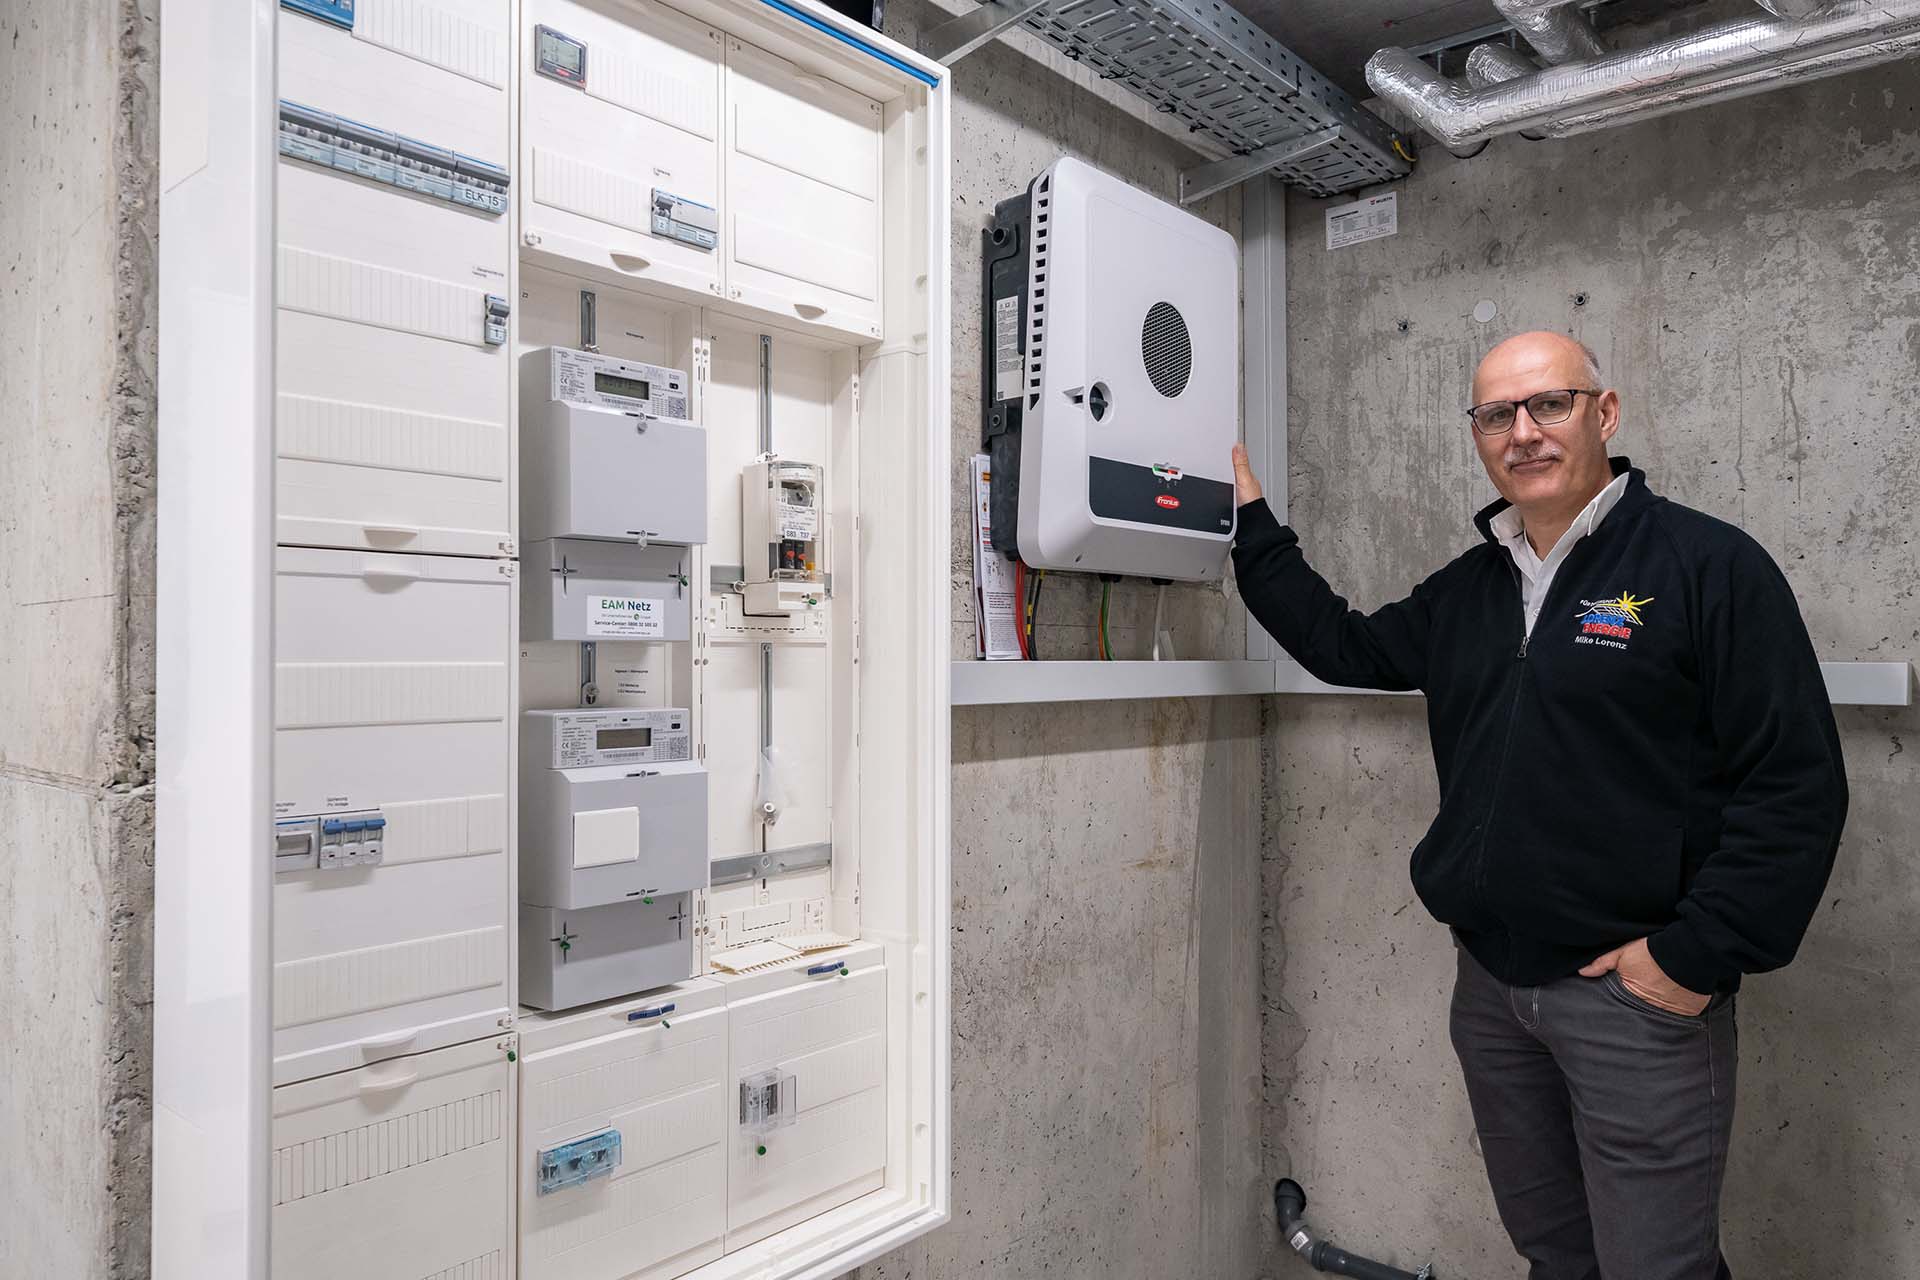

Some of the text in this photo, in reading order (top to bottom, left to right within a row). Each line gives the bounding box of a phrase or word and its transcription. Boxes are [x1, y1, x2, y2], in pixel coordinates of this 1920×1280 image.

[465, 188, 499, 207] ELK 15
[1157, 496, 1180, 507] Fronius
[601, 599, 652, 612] EAM Netz
[1581, 613, 1625, 626] LORENZ
[1582, 623, 1632, 640] ENERGIE
[1574, 635, 1628, 650] Mike Lorenz
